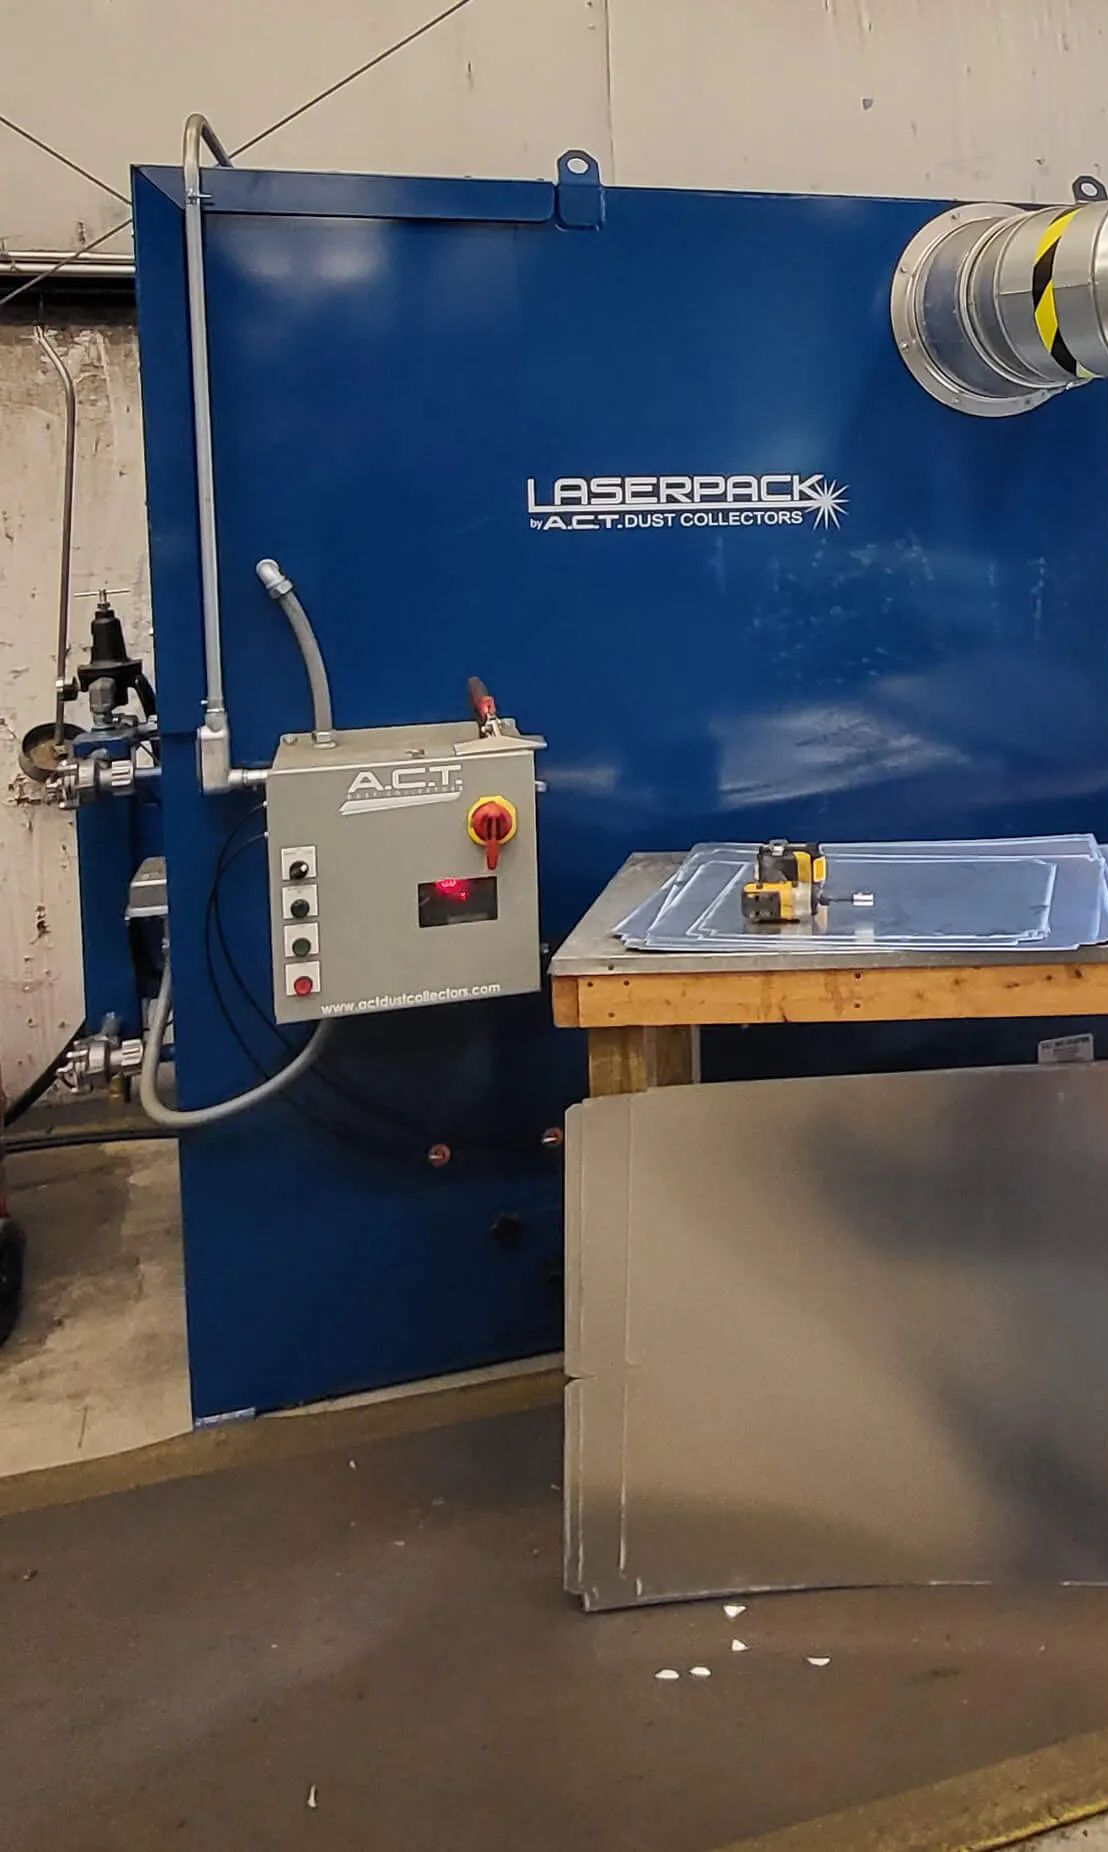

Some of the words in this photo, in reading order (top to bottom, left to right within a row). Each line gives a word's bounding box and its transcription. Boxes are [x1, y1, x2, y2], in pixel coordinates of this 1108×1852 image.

[527, 474, 824, 513] LASERPACK
[530, 518, 543, 530] by
[543, 514, 624, 531] A.C.T.
[625, 513, 676, 528] DUST
[680, 511, 803, 527] COLLECTORS
[348, 764, 463, 793] A.C.T.
[320, 983, 501, 1015] www.actdustcollectors.com
